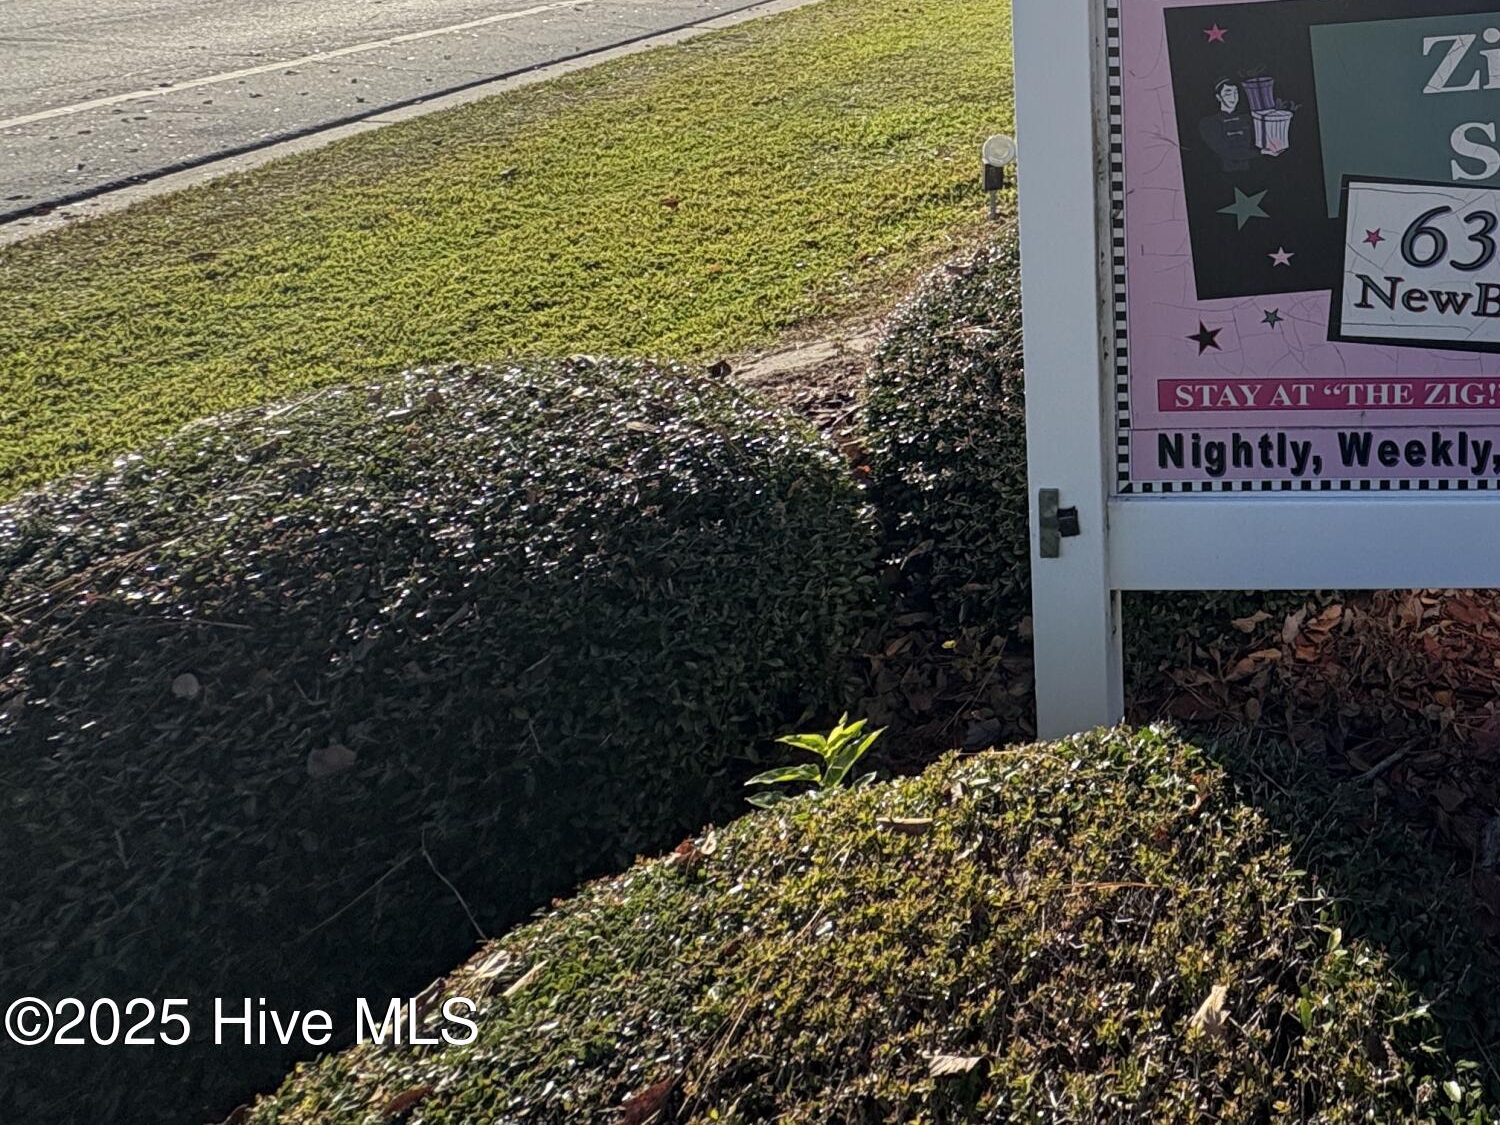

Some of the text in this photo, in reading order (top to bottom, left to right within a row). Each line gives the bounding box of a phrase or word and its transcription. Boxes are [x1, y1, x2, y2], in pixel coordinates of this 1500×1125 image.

[1174, 385, 1261, 408] STAY
[1270, 384, 1315, 407] AT
[1157, 432, 1322, 476] Nightly,
[1338, 431, 1500, 475] Weekly,
